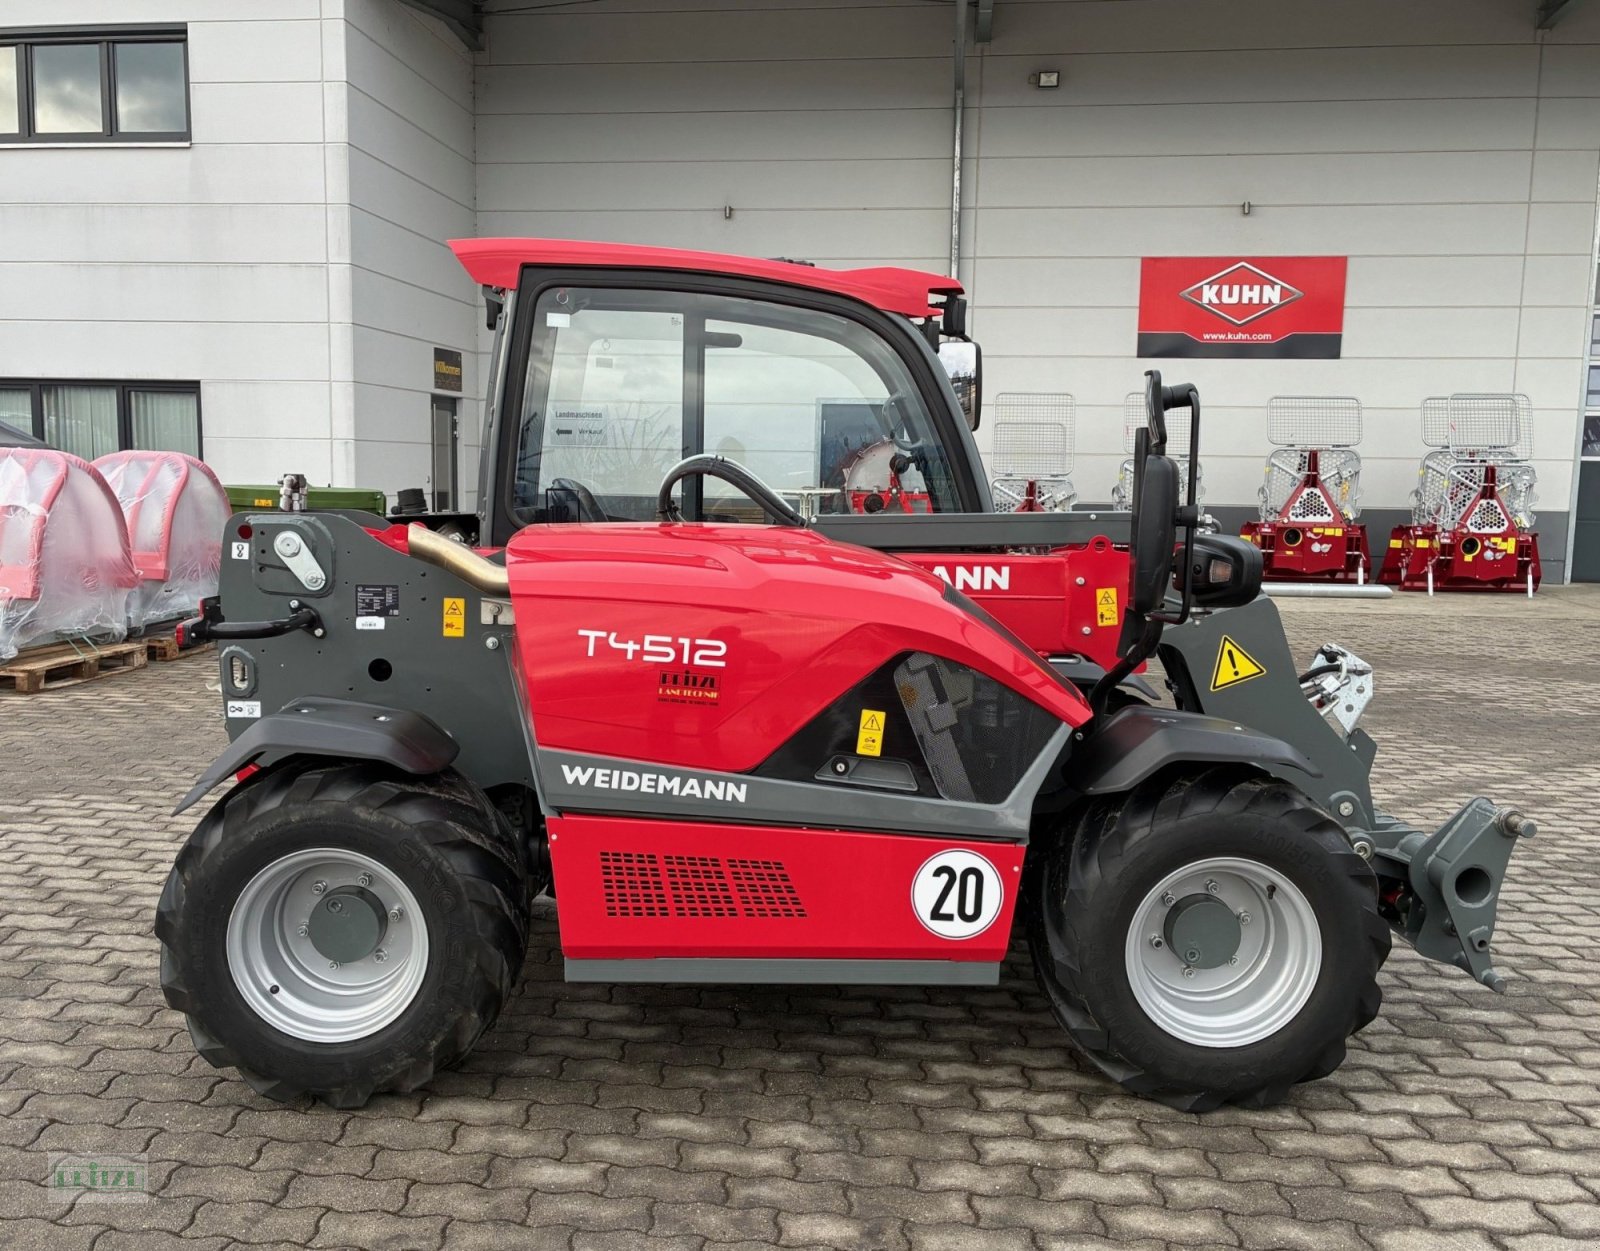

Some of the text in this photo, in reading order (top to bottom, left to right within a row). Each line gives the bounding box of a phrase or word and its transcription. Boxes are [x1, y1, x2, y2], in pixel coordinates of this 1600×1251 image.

[1202, 284, 1281, 304] KUHN
[1203, 332, 1272, 341] www.kuhn.com
[555, 410, 603, 419] Landmaschinen
[577, 629, 727, 668] T4512
[561, 764, 747, 803] WEIDEMANN
[929, 865, 984, 923] 20
